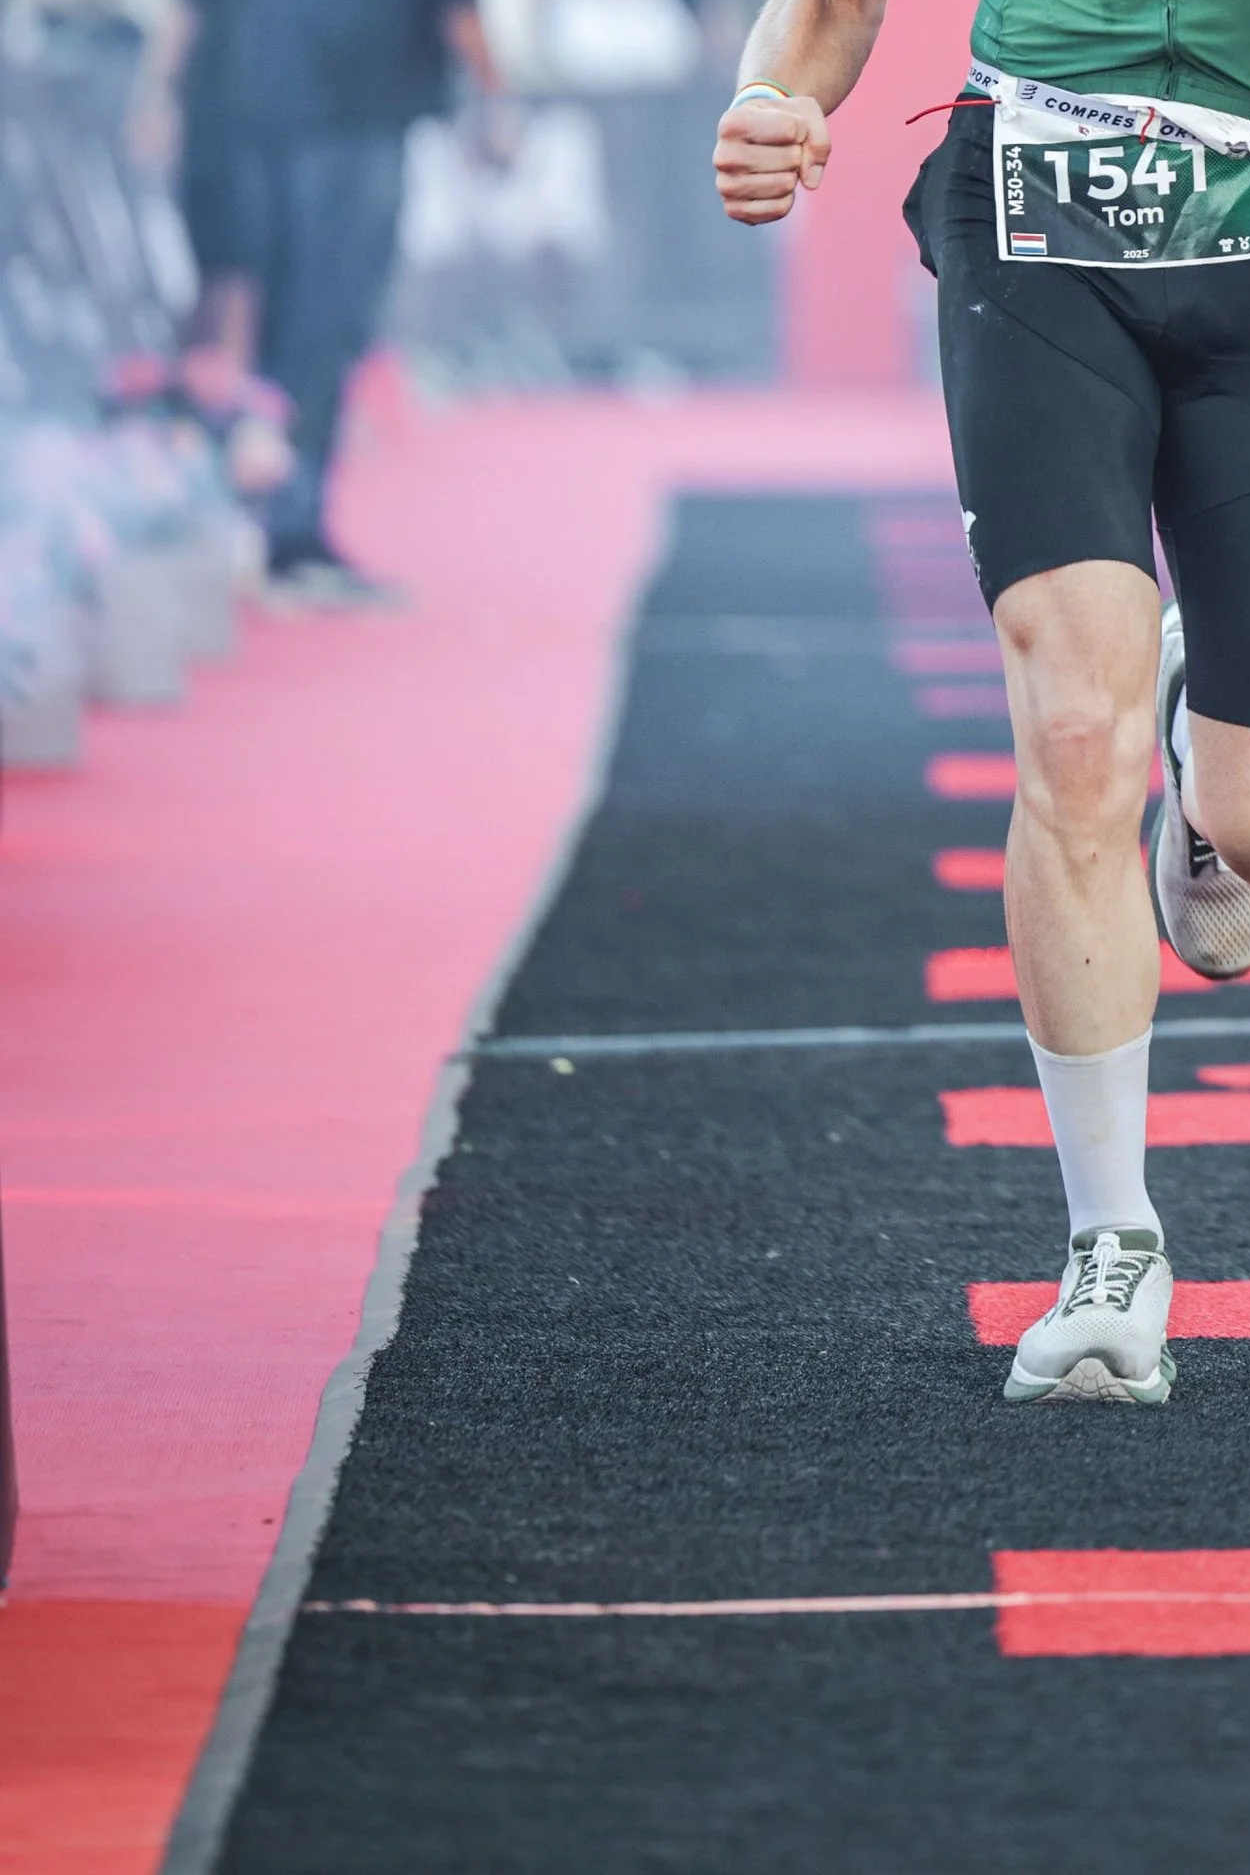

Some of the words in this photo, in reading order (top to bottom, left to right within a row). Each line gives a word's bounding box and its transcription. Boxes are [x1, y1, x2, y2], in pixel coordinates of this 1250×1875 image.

[1006, 145, 1025, 216] M30-34
[1044, 142, 1207, 203] 1541
[1102, 206, 1165, 227] Tom
[1123, 249, 1150, 260] 2025
